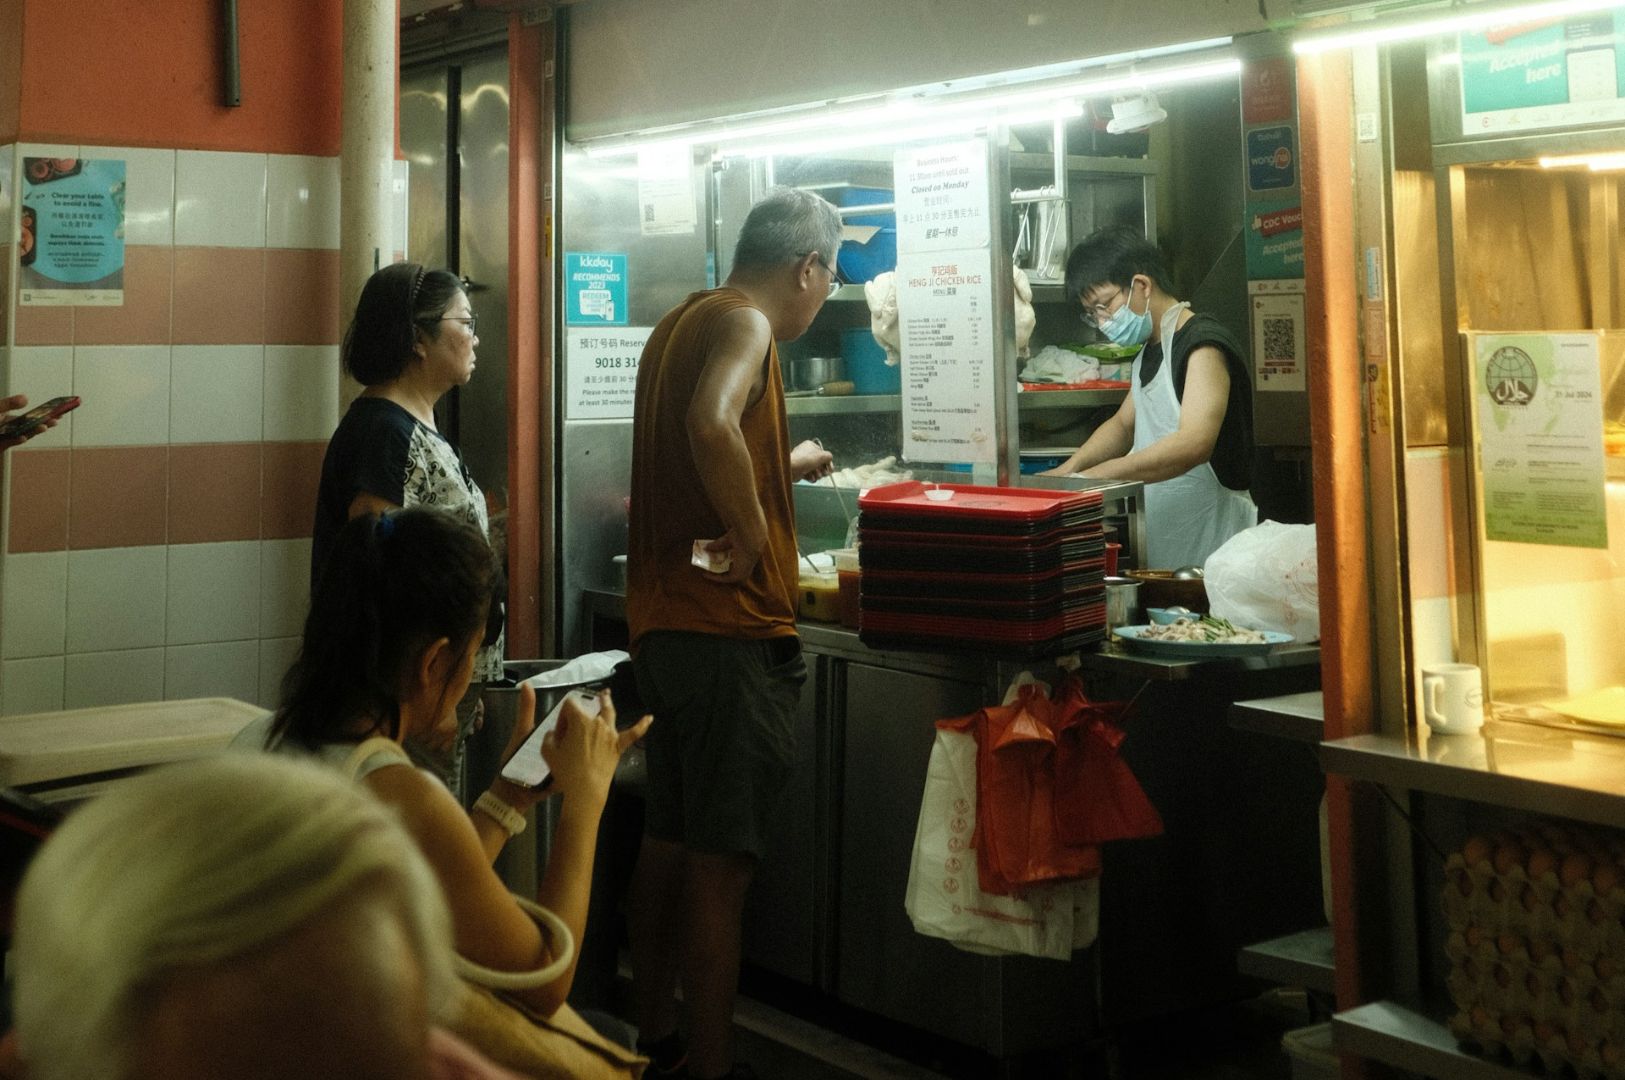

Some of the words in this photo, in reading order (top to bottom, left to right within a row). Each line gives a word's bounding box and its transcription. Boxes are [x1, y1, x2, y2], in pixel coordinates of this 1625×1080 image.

[1526, 65, 1561, 84] here
[911, 184, 932, 194] Closed
[942, 180, 970, 190] Monday
[51, 191, 69, 199] Clear
[87, 192, 105, 200] table
[1263, 217, 1280, 229] CDC
[580, 256, 613, 272] kkday
[573, 273, 620, 282] RECOMMENDS
[908, 278, 927, 288] HENG
[936, 276, 965, 286] CHICKEN
[967, 275, 982, 285] RICE
[580, 338, 618, 349] 预订号码
[595, 357, 622, 368] 9018
